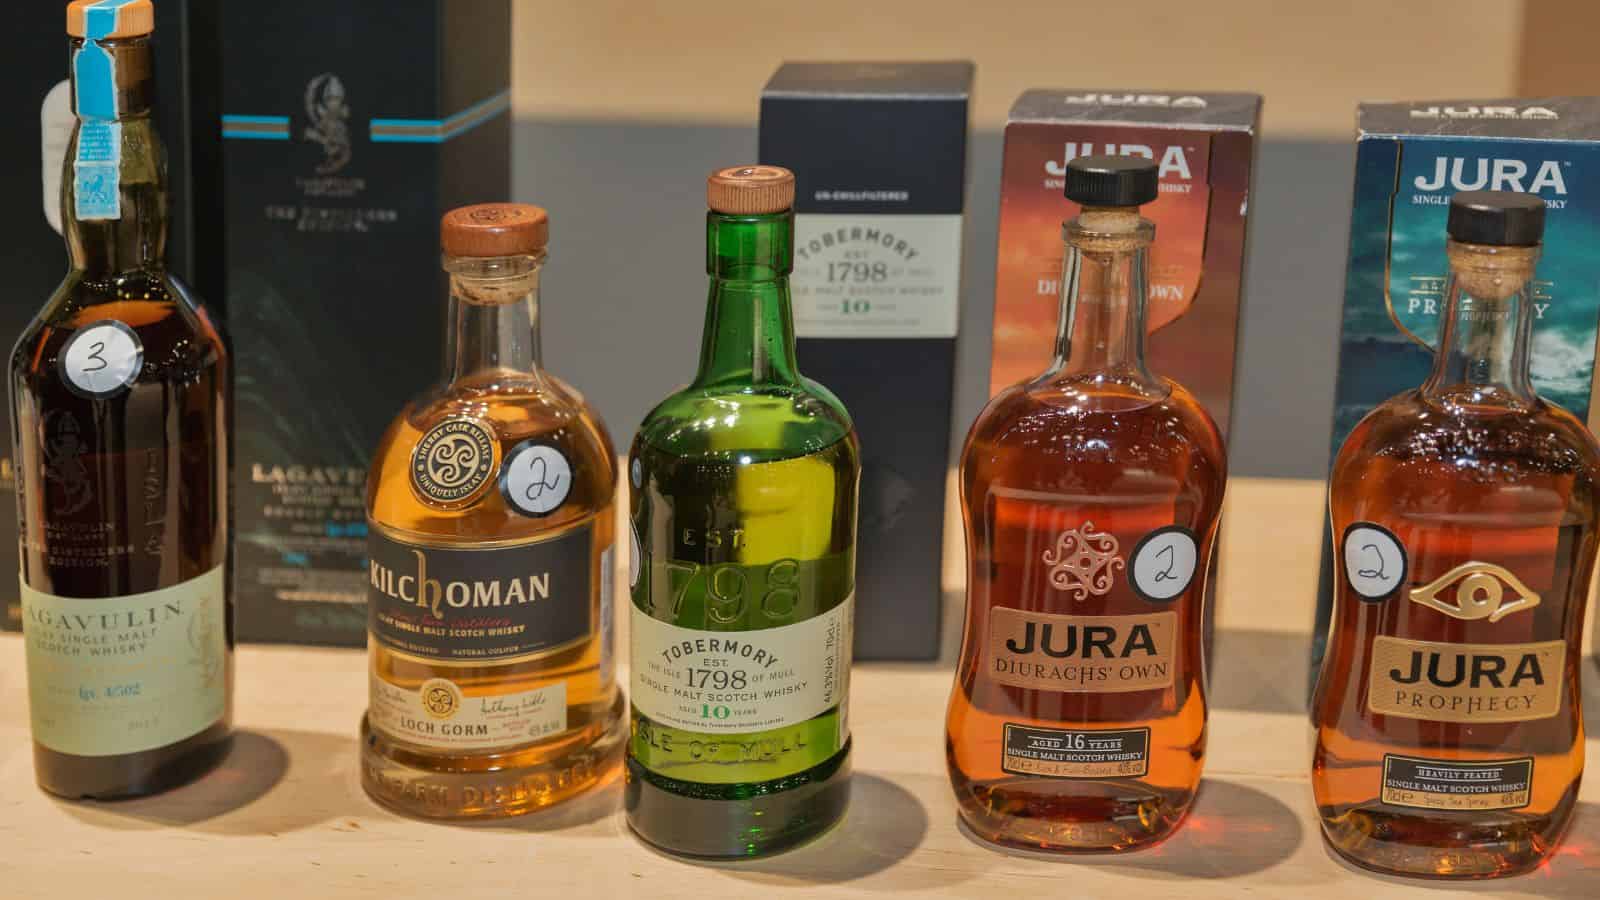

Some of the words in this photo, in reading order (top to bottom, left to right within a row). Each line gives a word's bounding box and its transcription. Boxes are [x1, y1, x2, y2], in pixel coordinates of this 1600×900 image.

[1414, 156, 1568, 195] JURA
[797, 226, 920, 261] TOBERMORY
[827, 262, 889, 284] 1798
[82, 341, 108, 372] 3
[525, 456, 561, 500] 2
[1154, 544, 1178, 583] 2
[1357, 543, 1390, 580] 2
[423, 626, 447, 637] MALT
[449, 627, 486, 638] SCOTCH
[488, 624, 527, 636] WHISKY
[1006, 621, 1158, 659] JURA
[90, 642, 146, 657] WHISKY
[661, 638, 779, 669] TOBERMORY
[686, 667, 748, 690] 1798
[751, 674, 765, 683] OF
[769, 669, 796, 681] MULL
[1119, 662, 1168, 681] OWN
[1389, 650, 1545, 689] JURA
[674, 688, 701, 701] MALT
[708, 692, 758, 702] SCOTCH
[764, 681, 808, 699] WHISKY
[1395, 690, 1537, 714] PROPHECY
[701, 703, 731, 720] 10
[400, 715, 434, 735] LOCH
[441, 722, 489, 737] GORM
[1031, 739, 1061, 748] AGED
[1065, 733, 1085, 749] 16
[1088, 740, 1123, 749] YEARS
[1007, 747, 1039, 759] SINGLE
[1040, 751, 1065, 761] MALT
[1066, 752, 1105, 762] SCOTCH
[1107, 751, 1143, 762] WHISKY
[1386, 778, 1420, 791] SINGLE
[1422, 783, 1448, 793] MALT
[1450, 784, 1489, 794] SCOTCH
[1491, 782, 1526, 793] WHISKY
